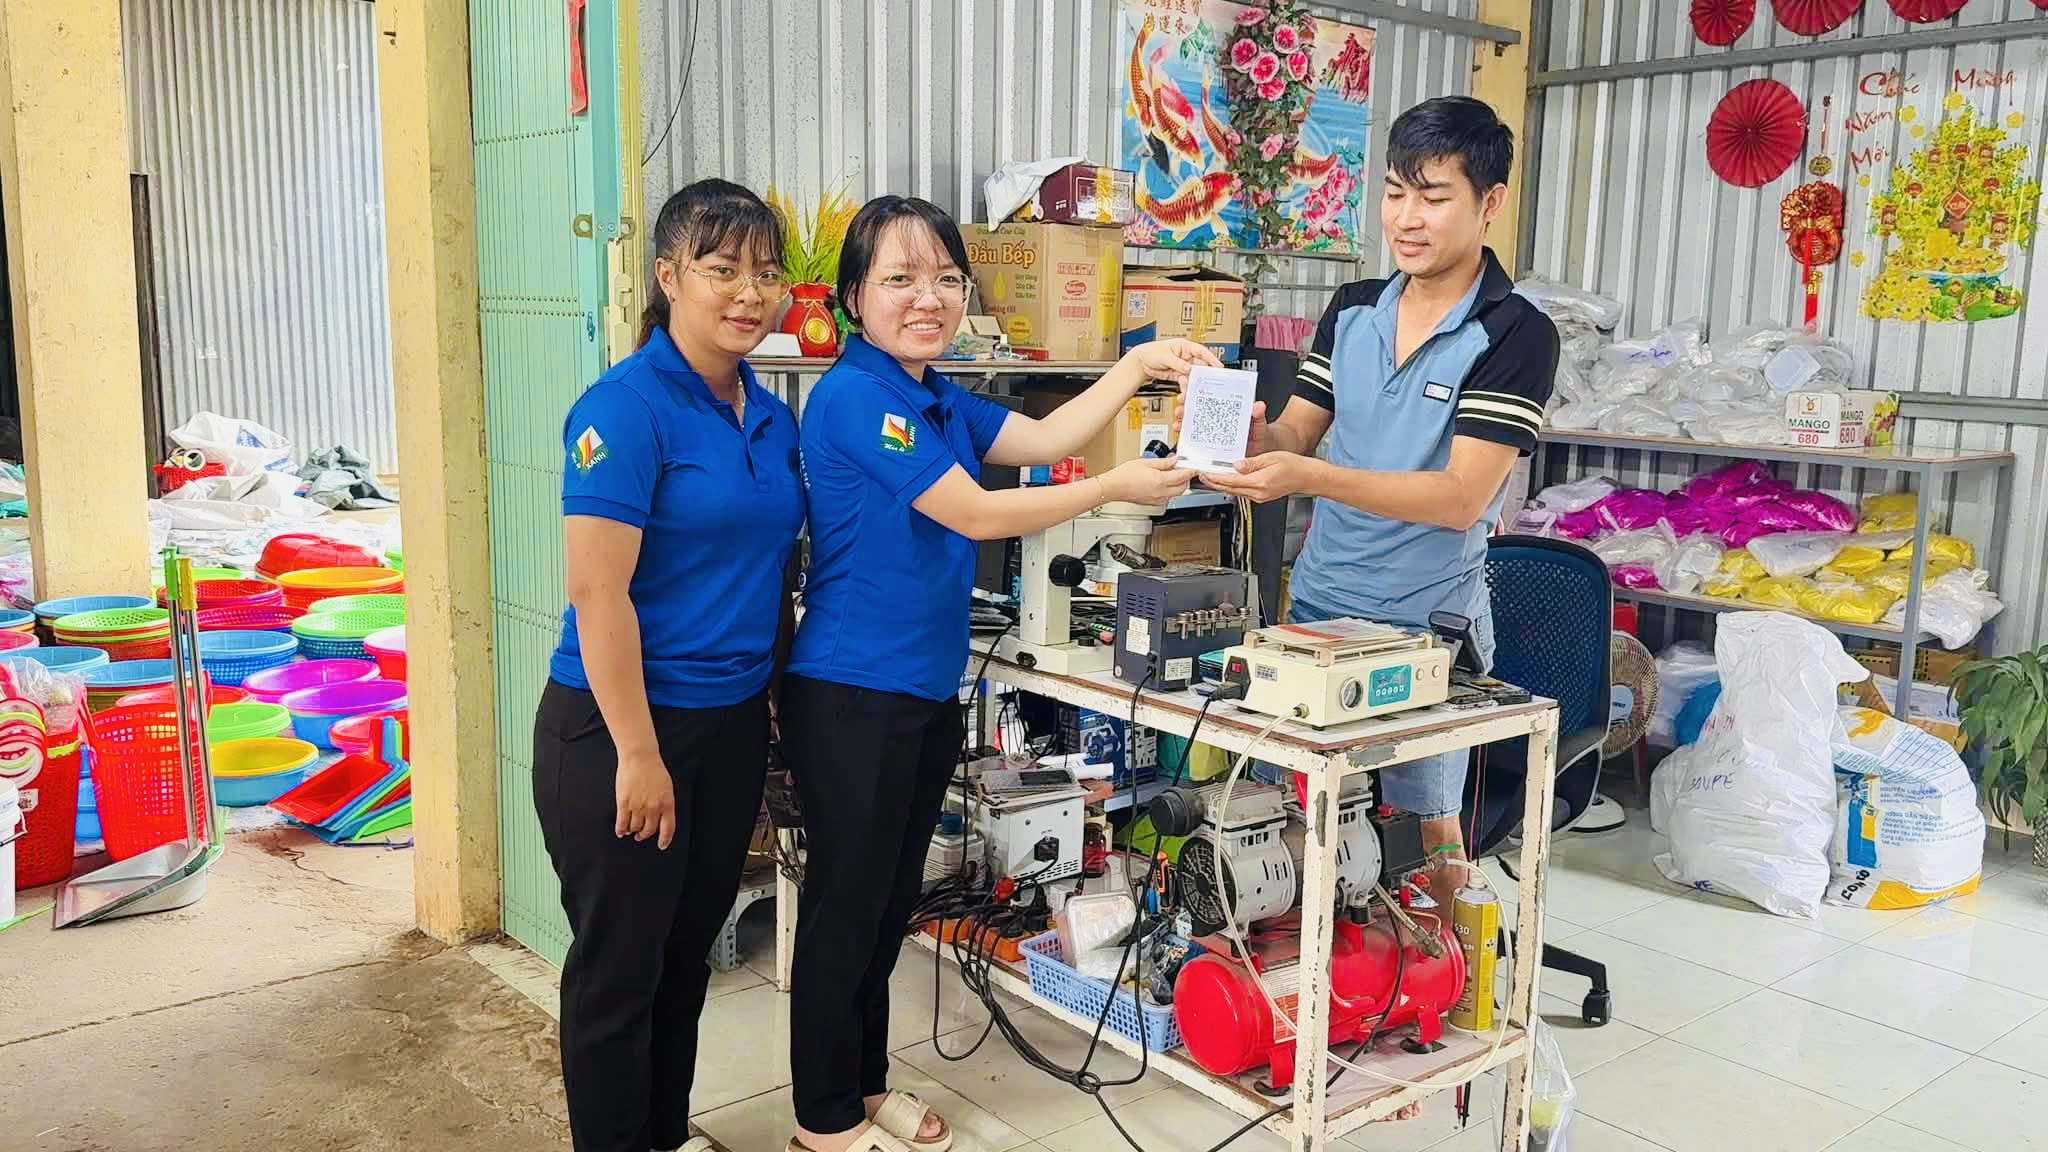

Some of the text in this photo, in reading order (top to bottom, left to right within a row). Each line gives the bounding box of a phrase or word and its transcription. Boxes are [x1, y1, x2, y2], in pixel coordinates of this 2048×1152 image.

[1845, 110, 1893, 138] Năm
[1001, 239, 1036, 269] Bếp
[1840, 410, 1864, 421] MANGO
[1789, 418, 1831, 429] MANGO
[1798, 433, 1819, 445] 680
[1839, 427, 1856, 443] 680
